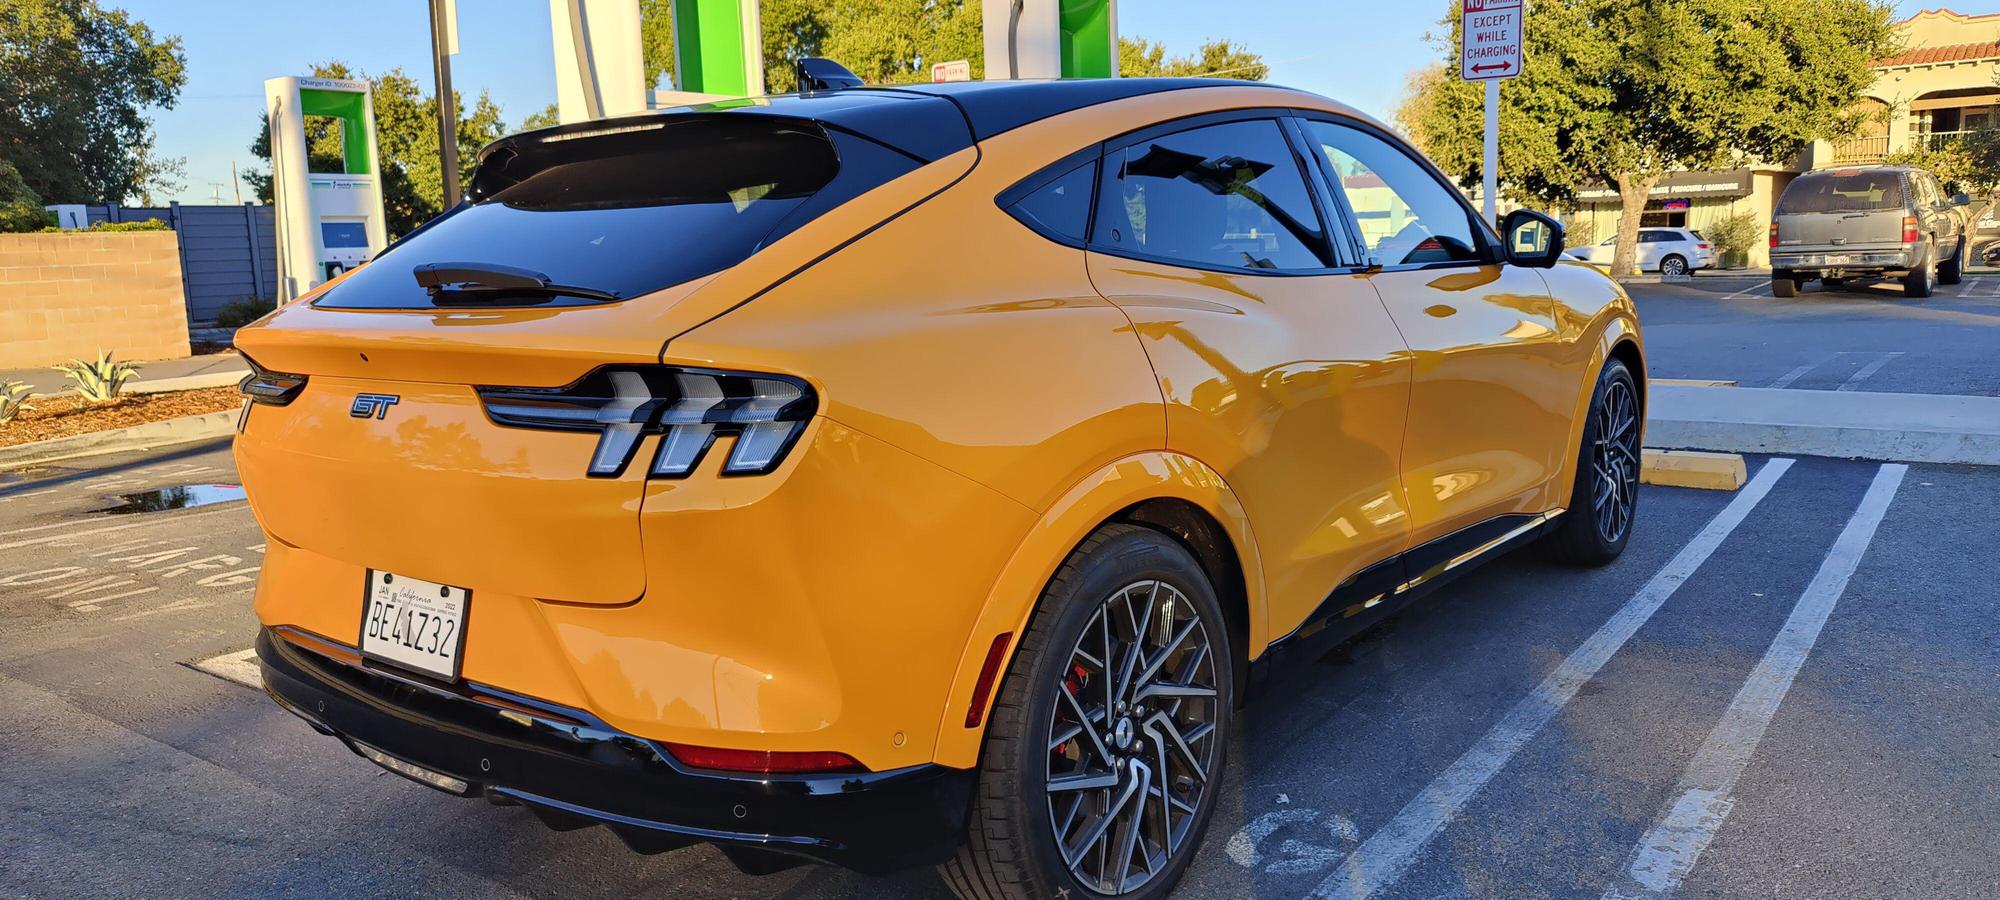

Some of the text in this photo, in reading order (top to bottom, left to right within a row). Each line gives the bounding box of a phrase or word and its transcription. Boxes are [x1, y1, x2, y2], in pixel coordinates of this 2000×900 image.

[1474, 14, 1512, 28] EXCEPT
[1477, 30, 1507, 42] WHILE
[1467, 45, 1516, 59] CHARGING
[300, 79, 324, 87] Charger
[350, 393, 400, 420] GT
[378, 585, 390, 596] JAN
[399, 586, 432, 605] California
[445, 602, 456, 611] 2022
[369, 601, 455, 658] BE41Z32
